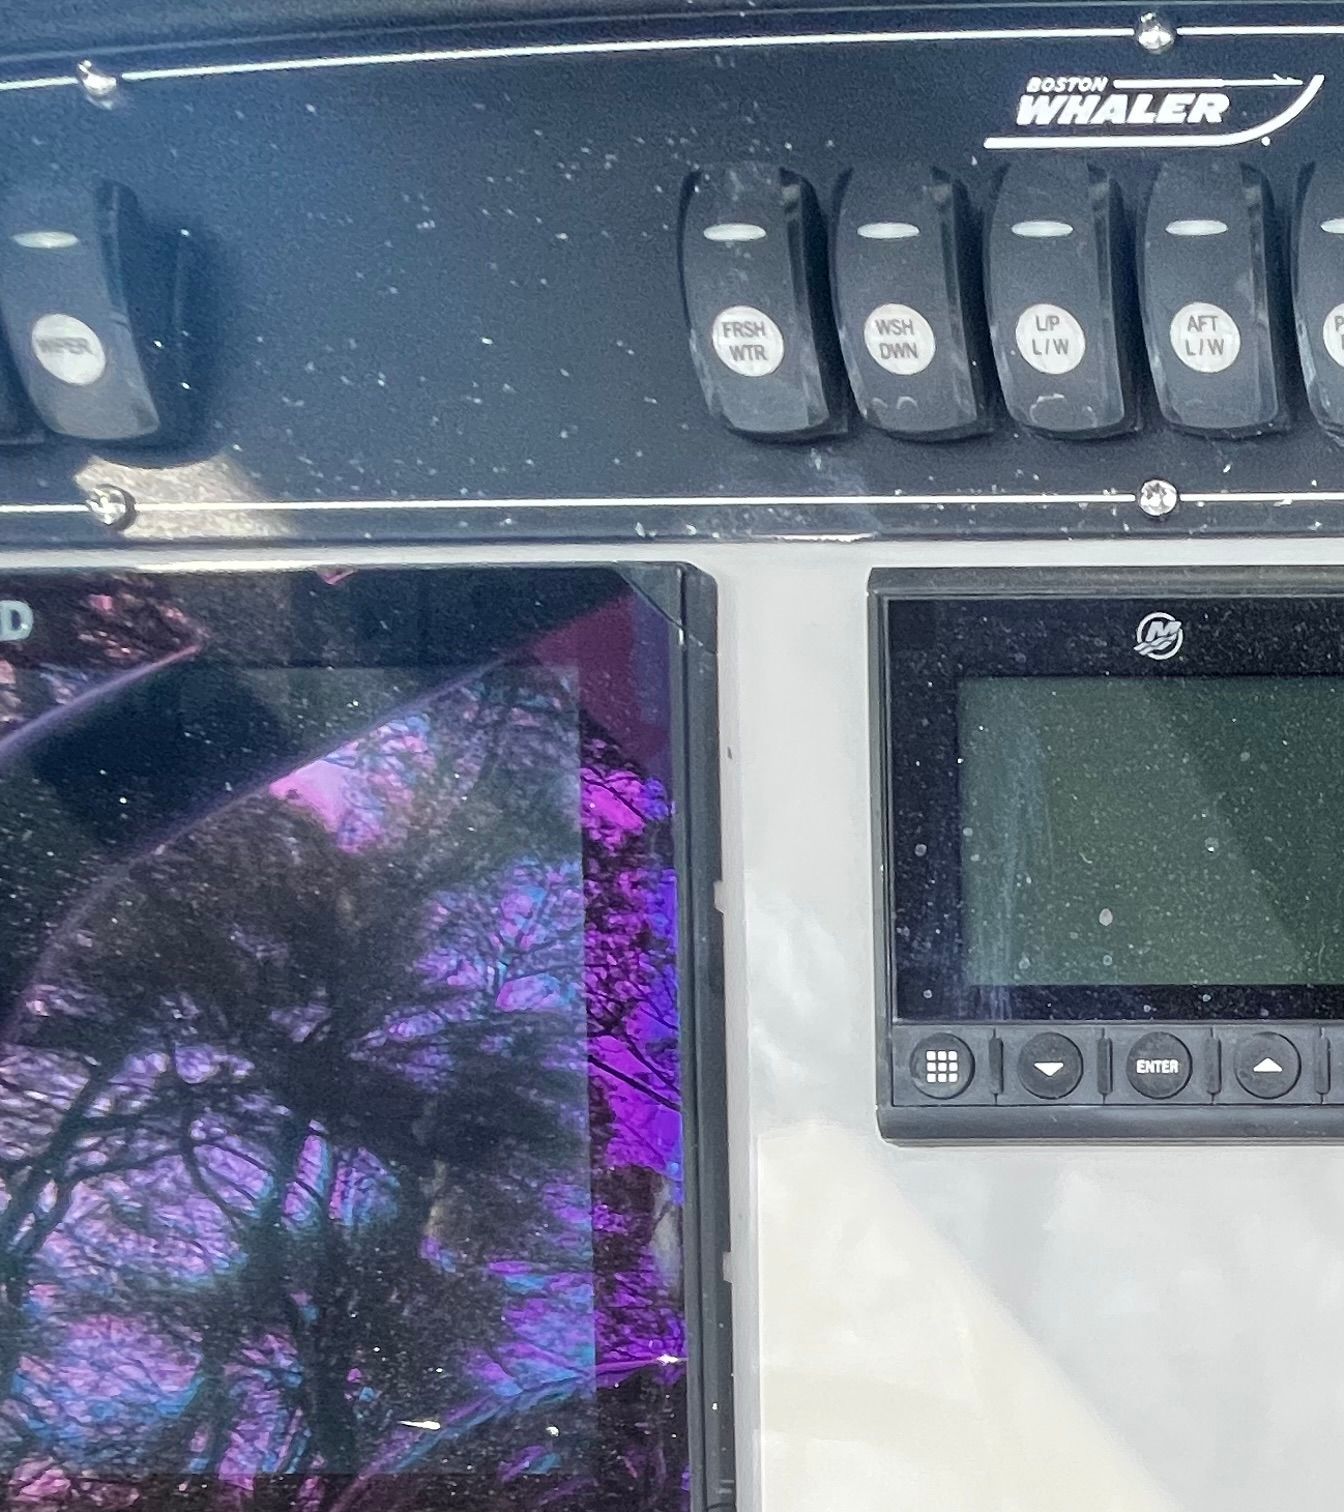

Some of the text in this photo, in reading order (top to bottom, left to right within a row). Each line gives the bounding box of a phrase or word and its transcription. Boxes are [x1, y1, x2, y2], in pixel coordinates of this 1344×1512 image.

[1026, 76, 1108, 93] BOSTON
[1016, 93, 1230, 125] WHALER
[722, 320, 767, 338] FRSH
[875, 319, 914, 337] WSH
[1187, 315, 1218, 332] AFT
[729, 344, 768, 361] WTR
[880, 341, 919, 359] DWN
[1136, 1060, 1179, 1075] ENTER
